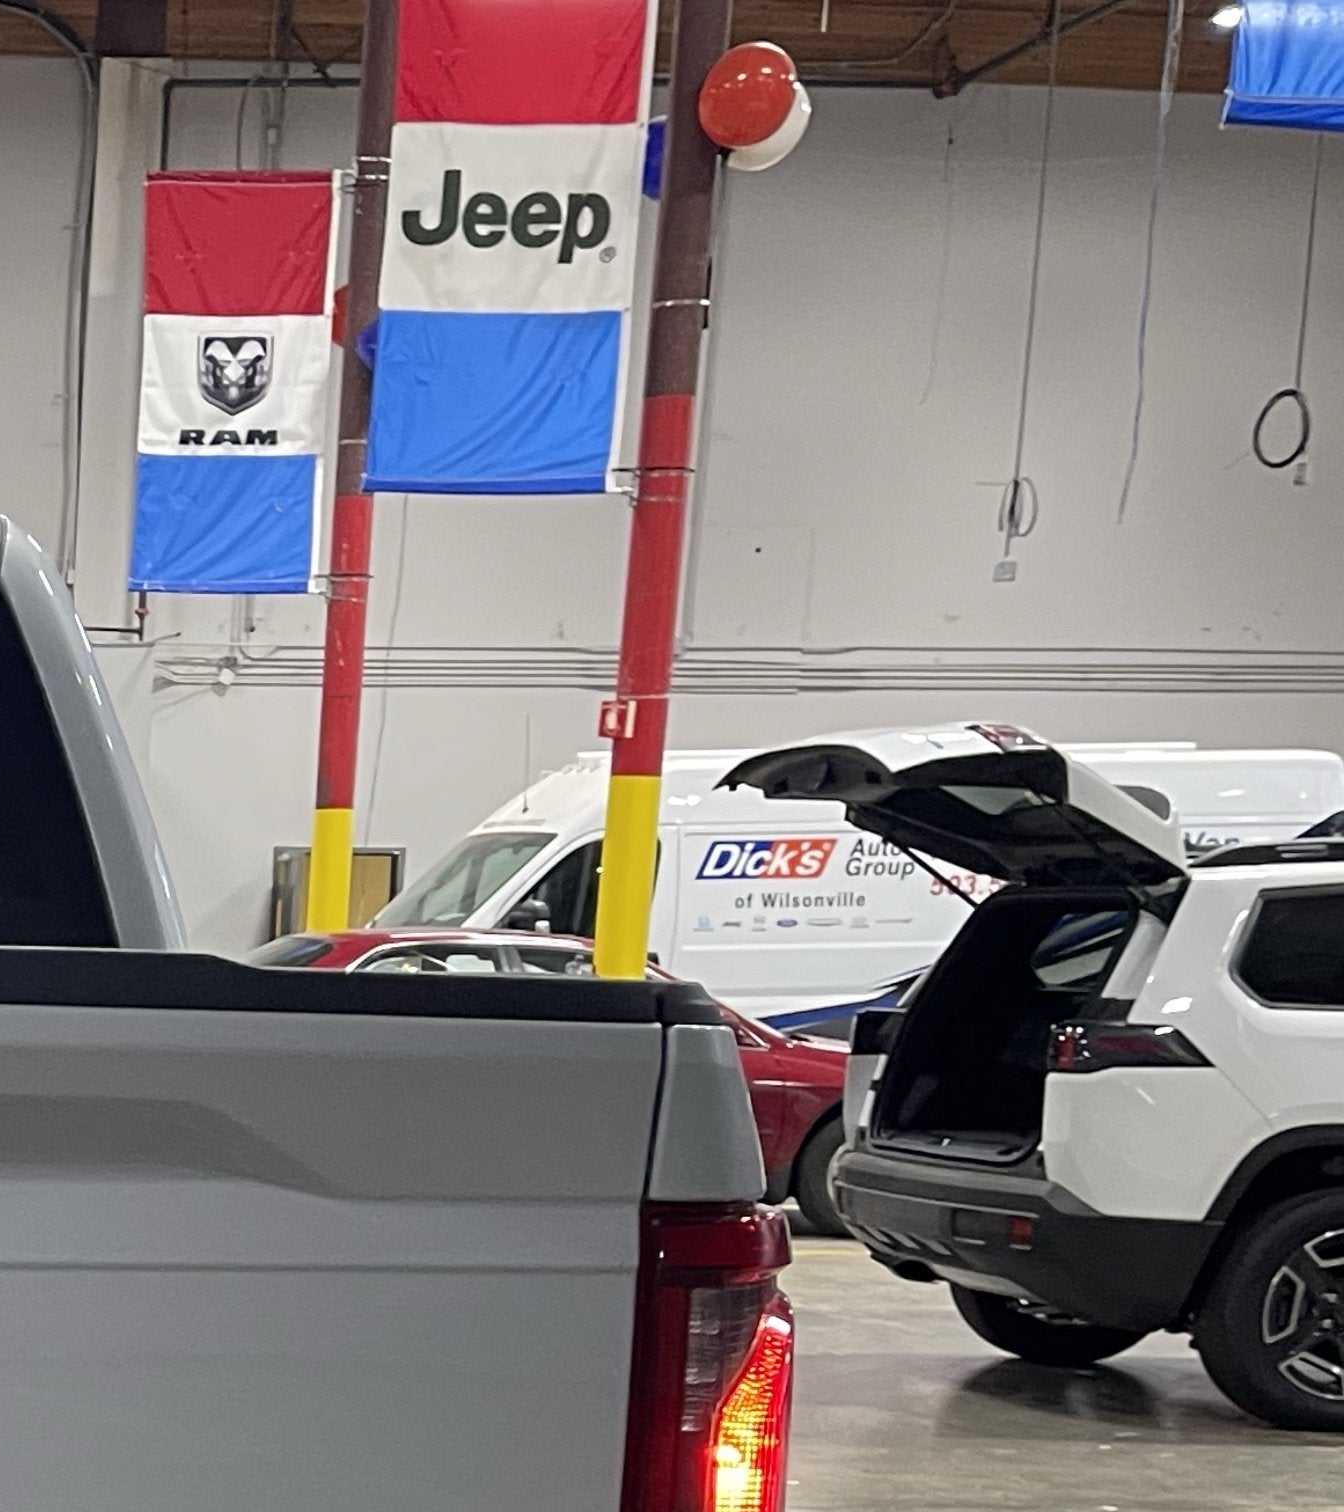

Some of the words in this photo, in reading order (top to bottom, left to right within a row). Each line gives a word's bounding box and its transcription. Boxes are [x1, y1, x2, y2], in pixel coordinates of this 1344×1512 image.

[401, 169, 611, 264] Jeep
[179, 429, 278, 445] RAM
[850, 838, 905, 857] Auto
[845, 857, 916, 880] Group
[734, 892, 753, 909] of
[761, 891, 867, 908] Wilsonville
